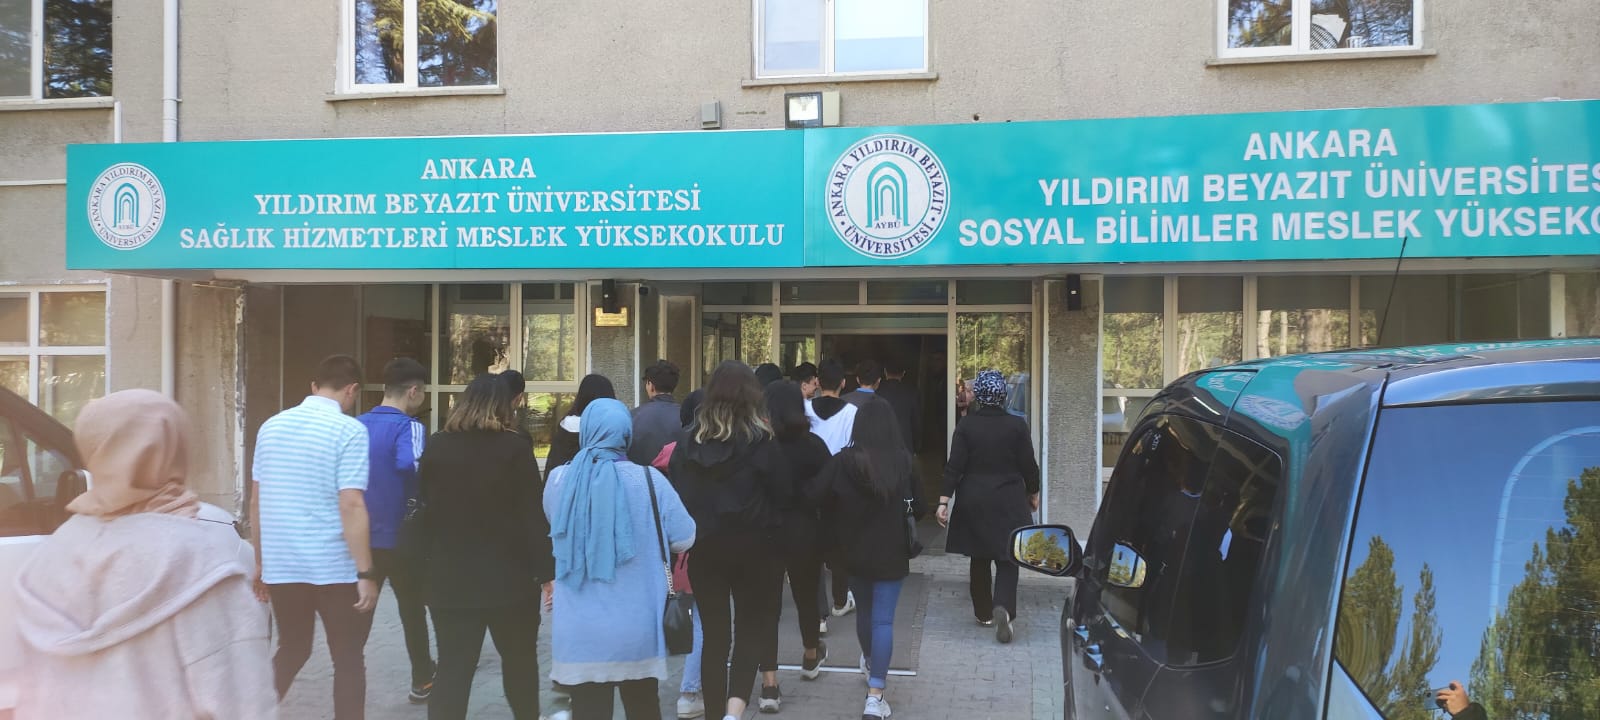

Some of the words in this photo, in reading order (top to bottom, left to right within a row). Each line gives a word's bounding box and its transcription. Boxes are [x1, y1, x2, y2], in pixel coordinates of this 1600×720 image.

[1243, 128, 1398, 161] ANKARA
[420, 157, 537, 180] ANKARA
[831, 163, 852, 217] ANKARA
[849, 139, 919, 162] YILDIRIM
[919, 154, 944, 215] BEYAZIT
[254, 193, 377, 215] YILDIRIM
[384, 192, 500, 214] BEYAZIT
[506, 182, 701, 213] ÜNİVERSİTESİ
[1038, 175, 1189, 206] YILDIRIM
[1203, 170, 1353, 202] BEYAZIT
[179, 222, 275, 249] SAĞLIK
[282, 220, 449, 249] HİZMETLERİ
[456, 225, 568, 248] MESLEK
[574, 218, 786, 247] YÜKSEKOKULU
[959, 216, 1085, 247] SOSYAL
[1096, 208, 1258, 244] BİLİMLER
[1271, 209, 1422, 241] MESLEK
